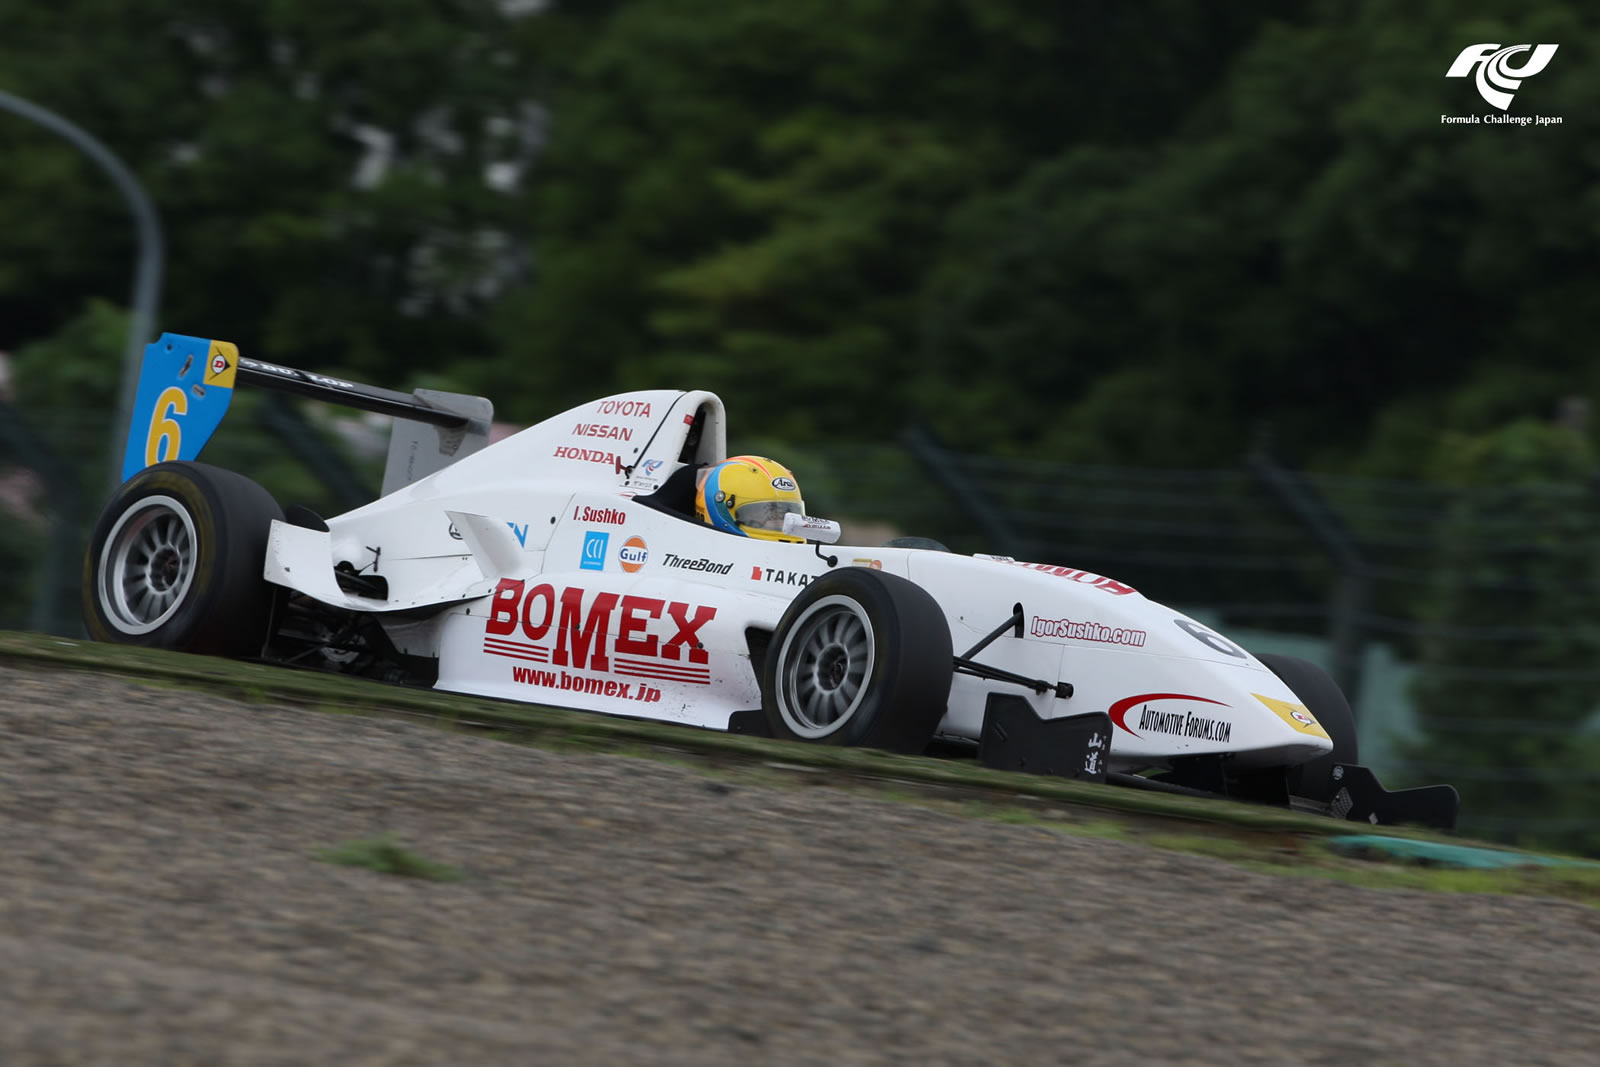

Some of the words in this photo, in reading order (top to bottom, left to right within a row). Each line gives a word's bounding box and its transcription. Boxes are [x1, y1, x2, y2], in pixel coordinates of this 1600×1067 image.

[597, 400, 651, 418] TOYOTA
[145, 386, 188, 468] 6
[572, 423, 633, 441] NISSAN
[553, 446, 615, 465] HONDA
[620, 548, 647, 562] Gulf
[662, 553, 734, 575] ThreeBond
[485, 578, 717, 672] BOMEX
[1031, 616, 1147, 647] IgorSushko.com
[1173, 619, 1248, 659] 6
[512, 666, 661, 702] www.bomex.jp
